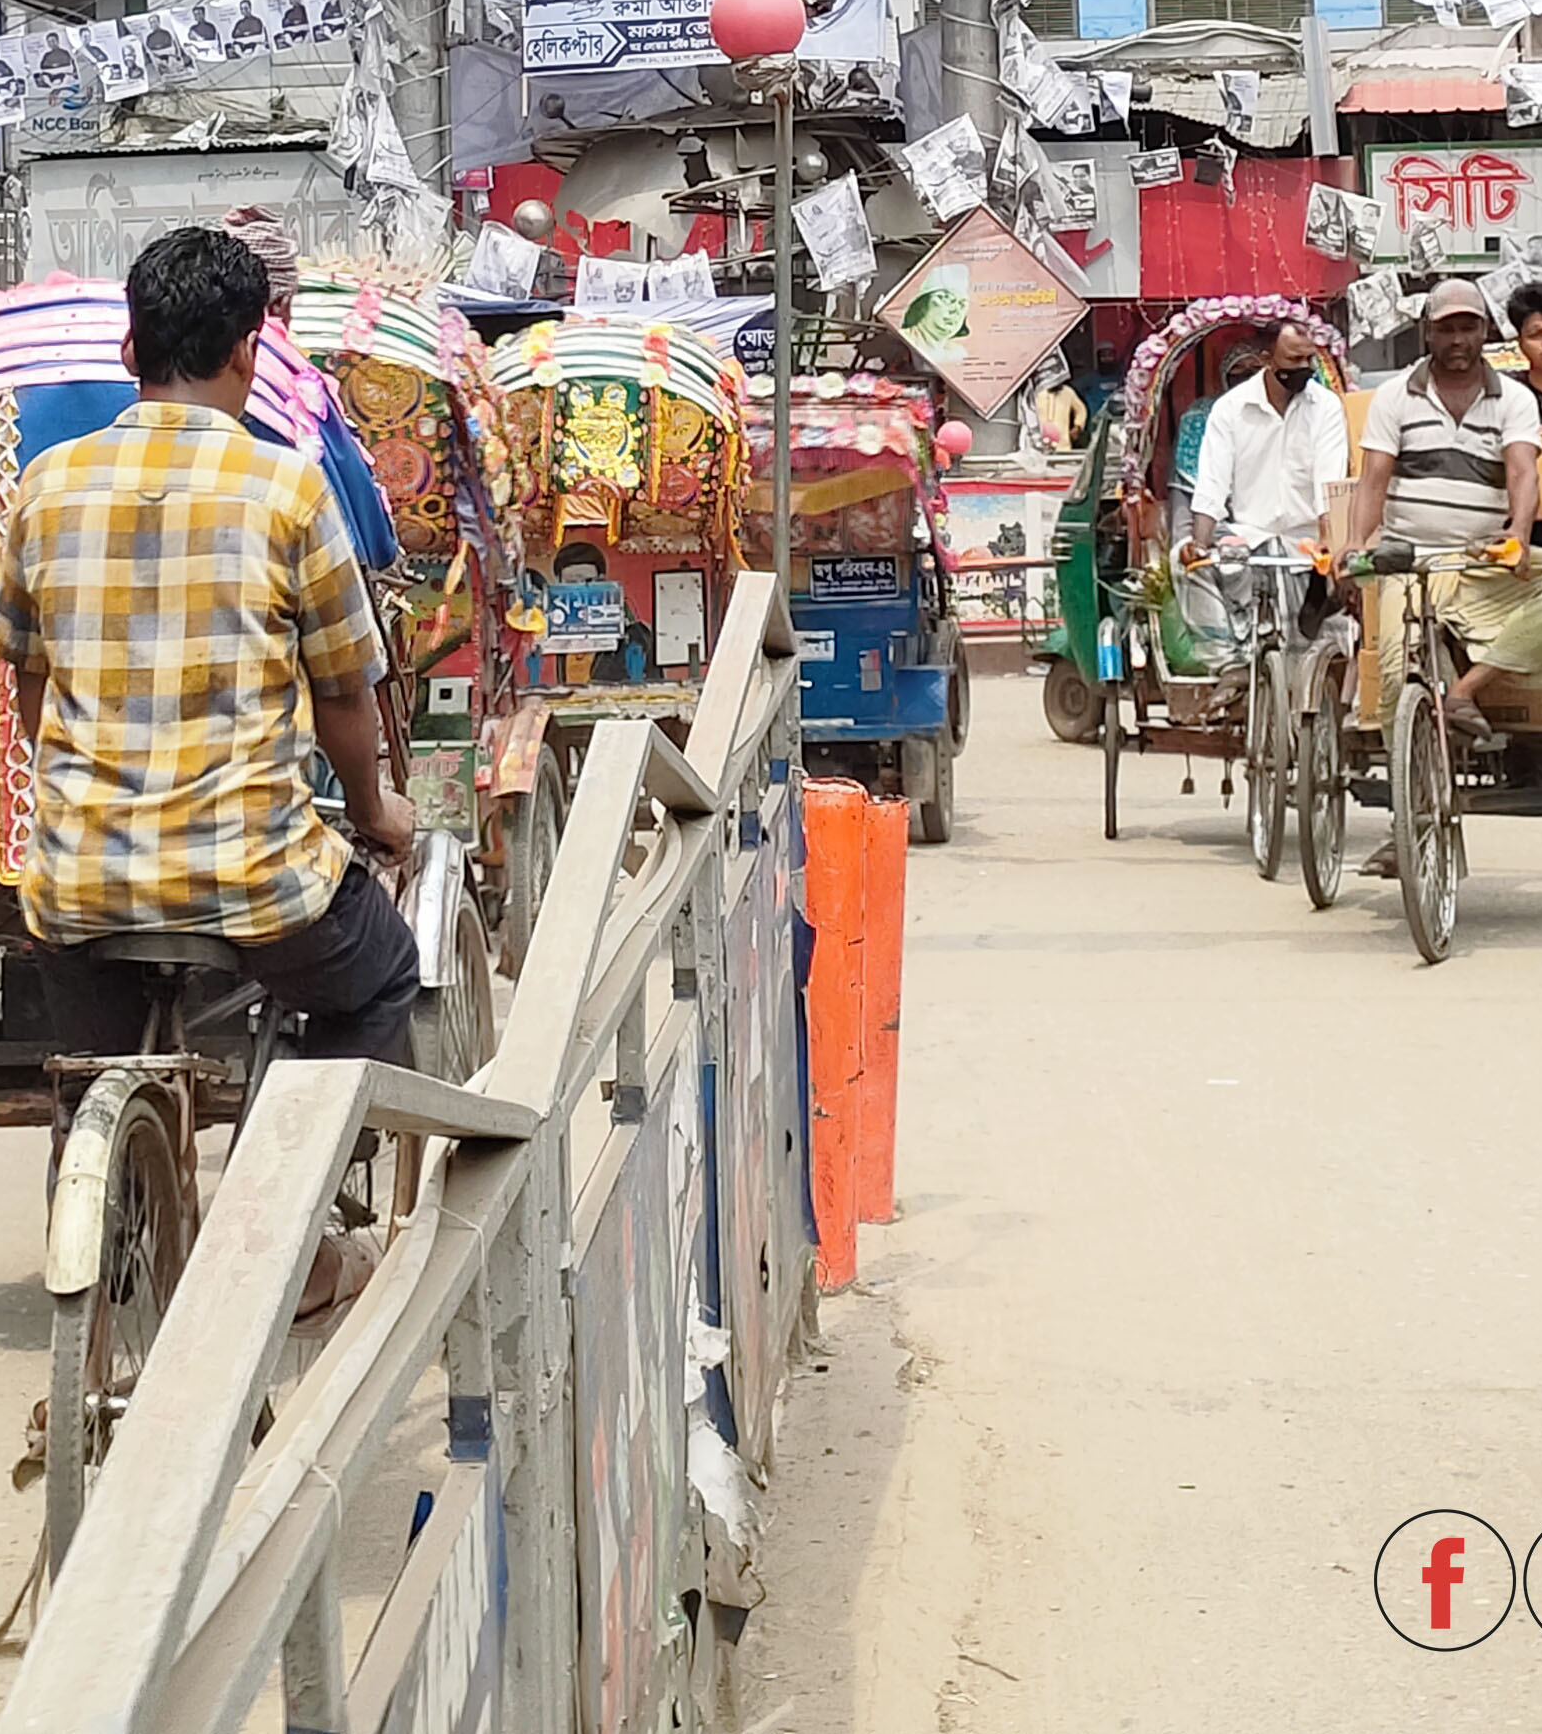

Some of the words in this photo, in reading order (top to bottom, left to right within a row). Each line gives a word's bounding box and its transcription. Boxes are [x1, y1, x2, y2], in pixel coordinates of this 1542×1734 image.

[525, 26, 605, 64] হেলিকপ্টার
[32, 117, 67, 131] NCC
[69, 117, 100, 131] Ban
[1383, 150, 1534, 234] সিটি
[737, 328, 776, 350] ঘোড়
